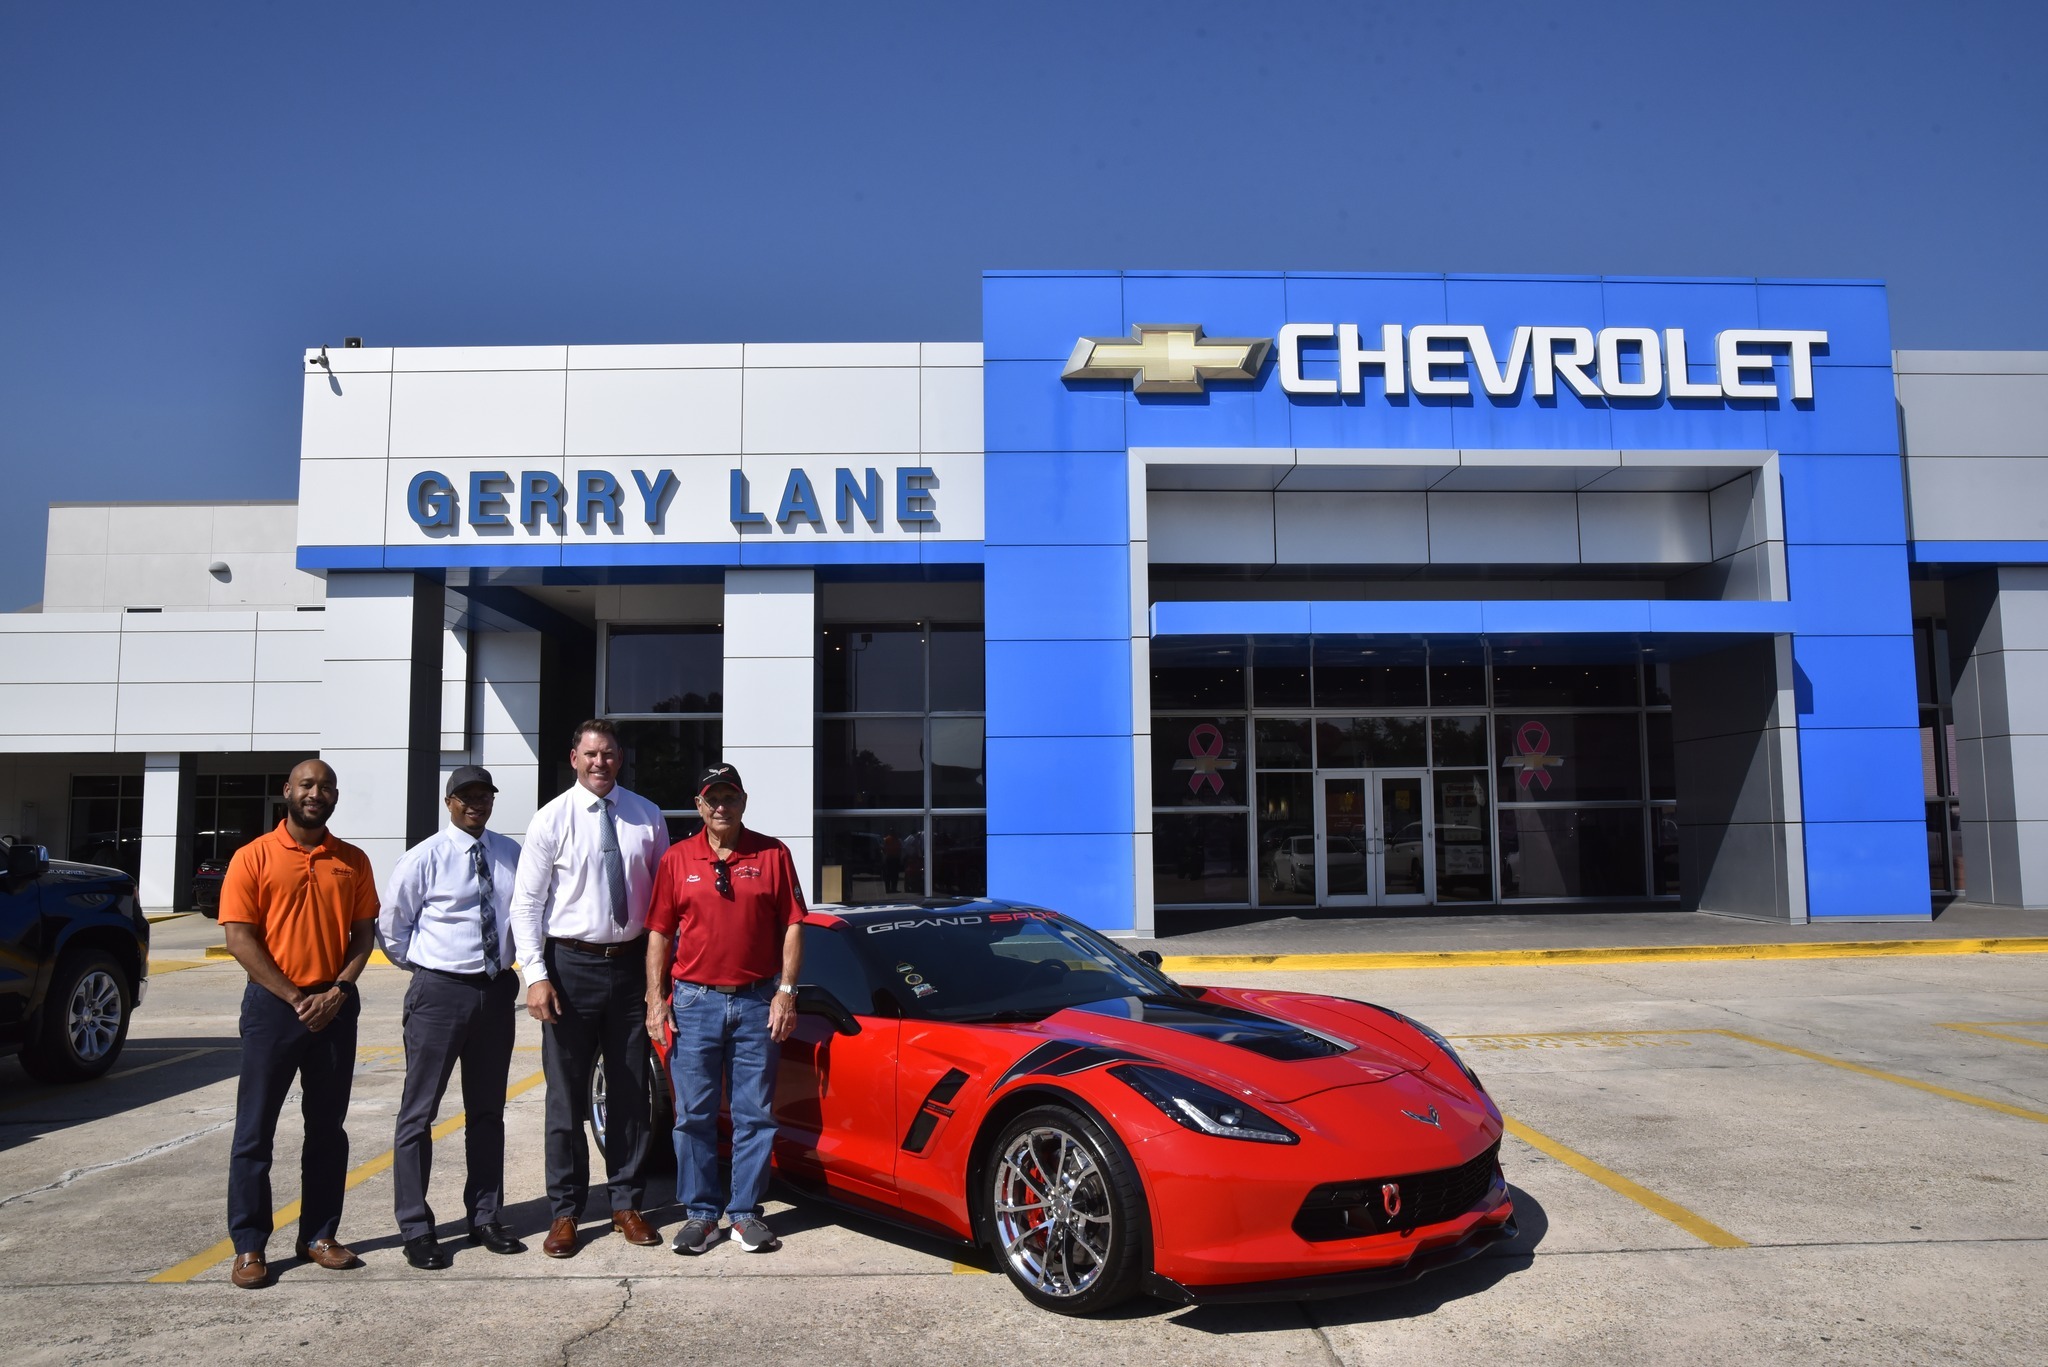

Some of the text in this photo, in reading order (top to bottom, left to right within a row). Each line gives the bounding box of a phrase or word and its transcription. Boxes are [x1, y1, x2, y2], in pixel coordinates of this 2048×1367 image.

[1277, 323, 1828, 400] CHEVROLET
[406, 467, 937, 529] GERRY LANE
[867, 916, 983, 934] GRAND
